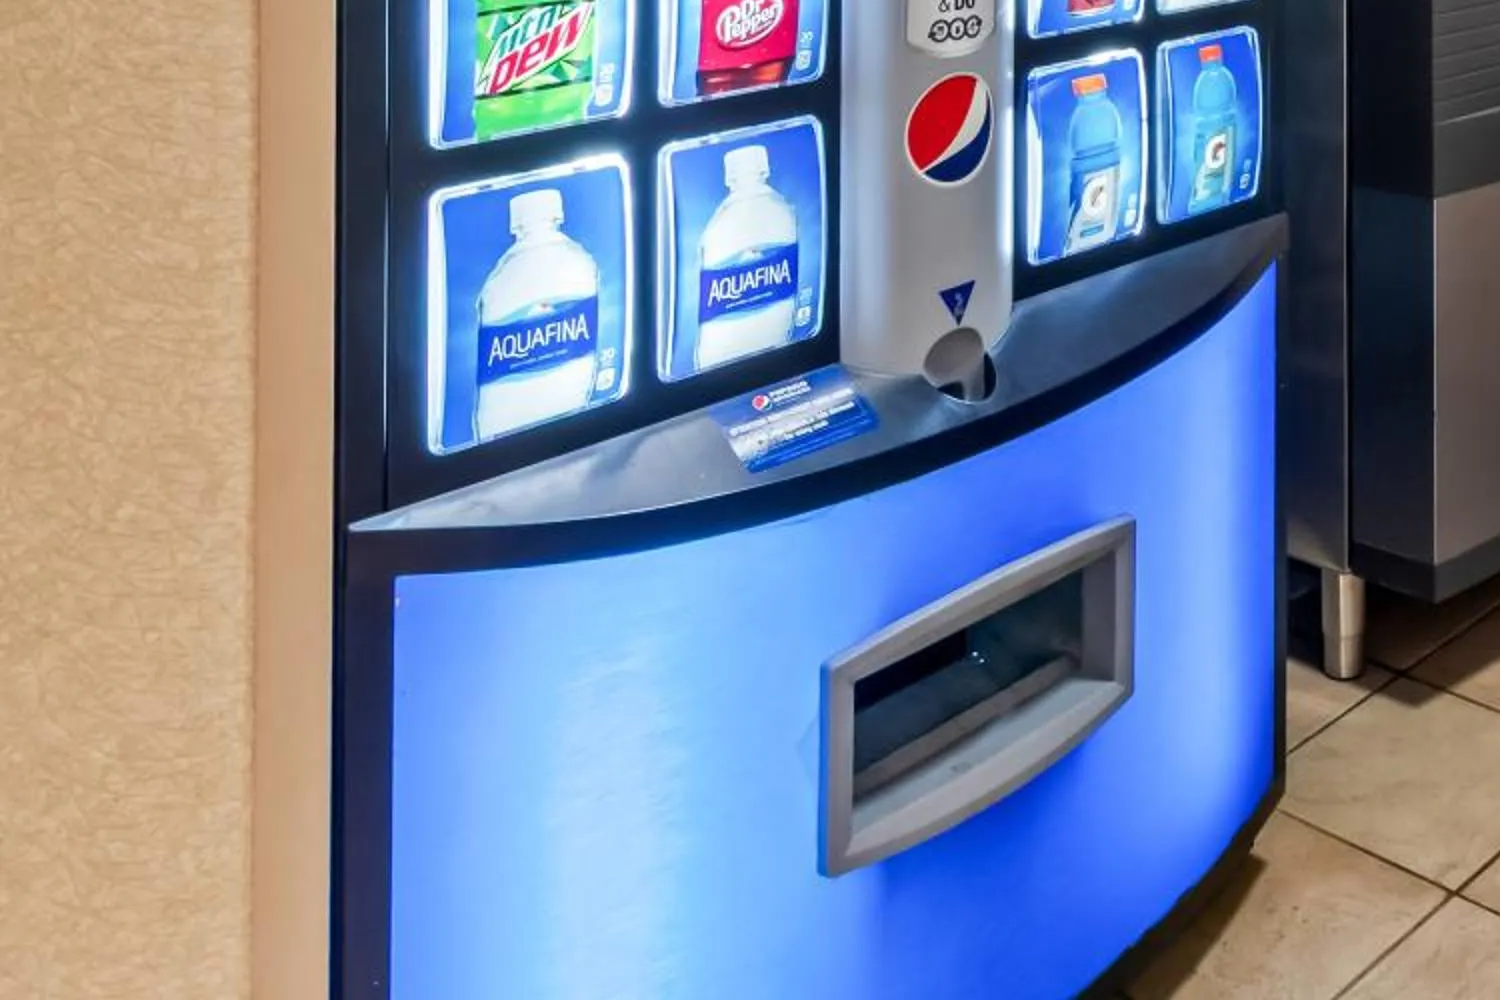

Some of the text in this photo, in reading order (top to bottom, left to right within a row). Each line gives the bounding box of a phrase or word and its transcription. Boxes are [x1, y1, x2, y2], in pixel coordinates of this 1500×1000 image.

[724, 4, 781, 43] Pepper
[708, 259, 792, 308] AQUAFINA
[487, 312, 591, 368] AQUAFINA
